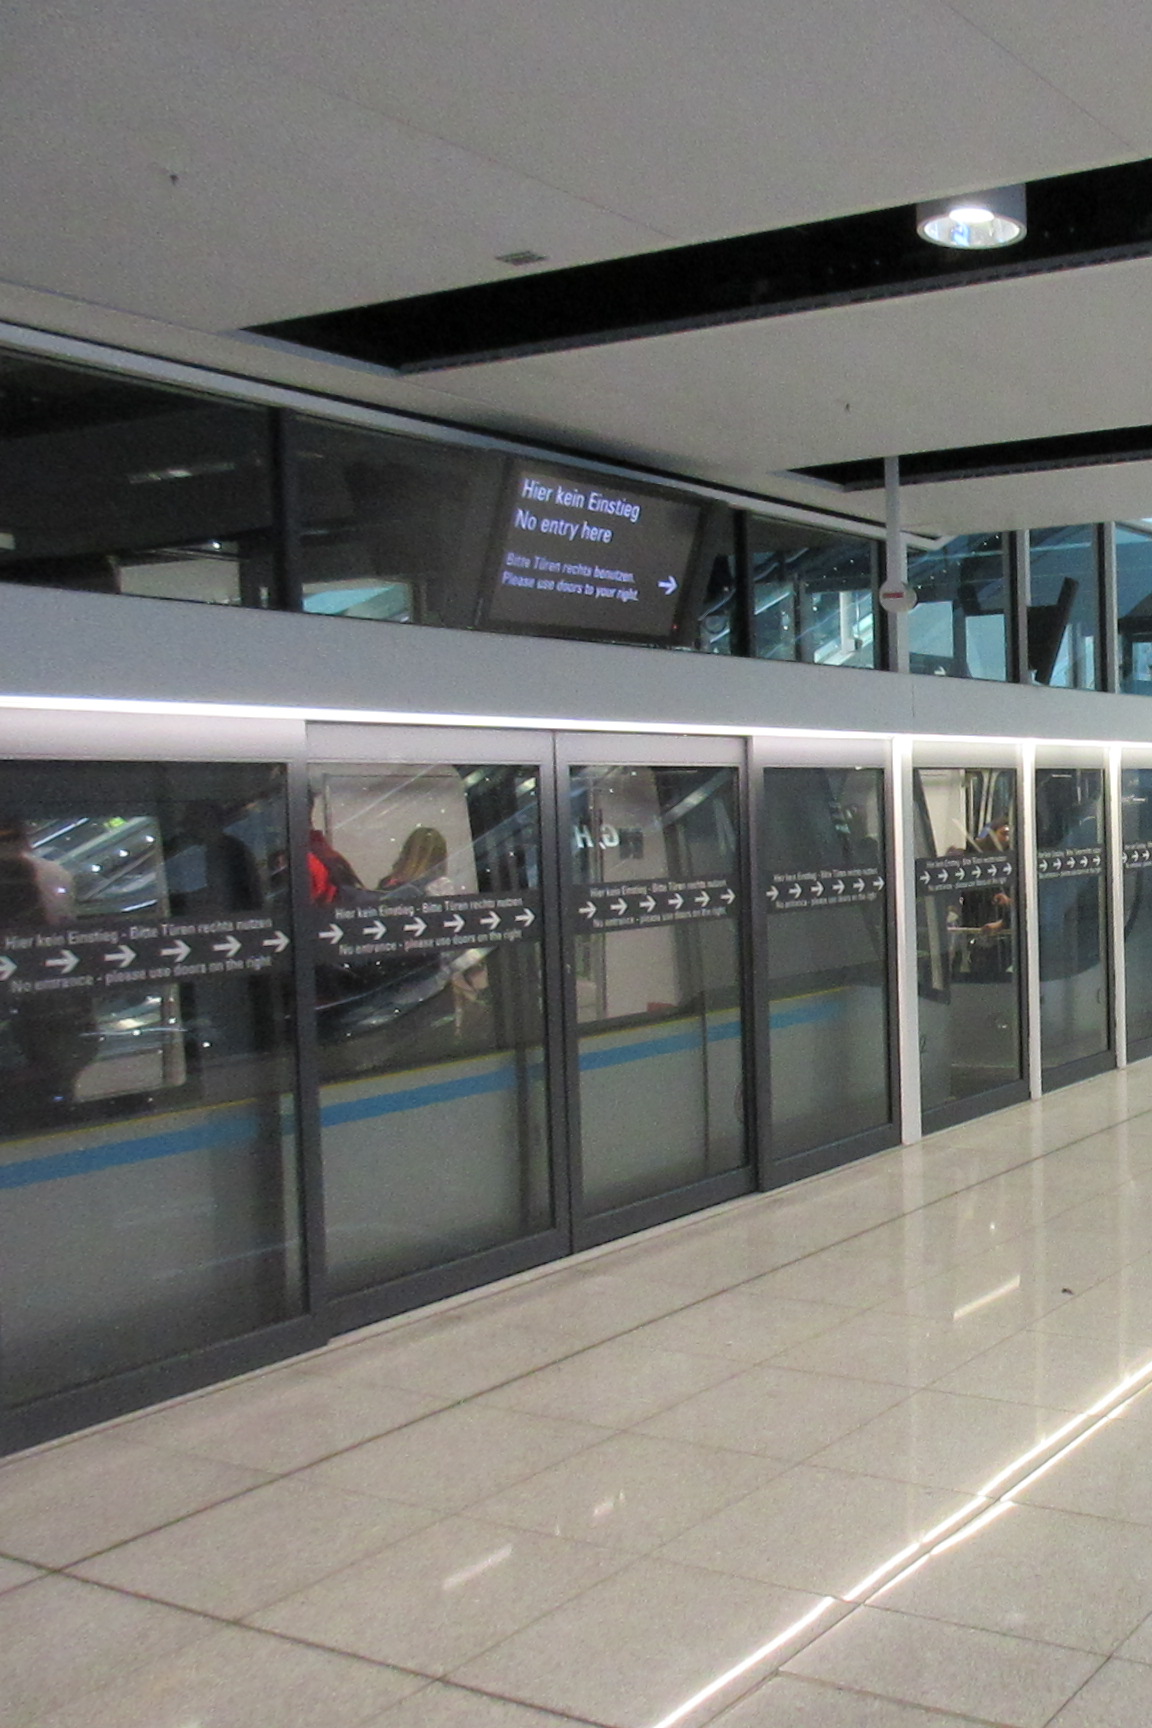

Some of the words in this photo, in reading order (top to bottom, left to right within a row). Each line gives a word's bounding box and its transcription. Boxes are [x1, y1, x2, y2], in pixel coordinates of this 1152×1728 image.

[521, 478, 553, 501] Hier
[555, 485, 584, 508] kein
[587, 491, 641, 522] Einstieg
[514, 508, 537, 531] No
[540, 517, 580, 541] entry
[581, 521, 613, 544] here
[506, 552, 531, 569] Bitte
[533, 555, 561, 573] Türen
[562, 561, 592, 577] rechts
[502, 571, 535, 588] Please
[537, 579, 555, 591] use
[556, 579, 583, 594] doors
[584, 583, 595, 596] to
[596, 586, 616, 599] your
[335, 908, 355, 919] Hier
[357, 906, 377, 918] kein
[5, 935, 33, 949] Hier
[37, 932, 65, 946] kein
[67, 930, 118, 945] Einstieg
[130, 925, 159, 940] Bitte
[162, 922, 195, 936] Türen
[12, 979, 31, 993] No
[105, 969, 147, 986] please
[150, 967, 171, 979] use
[174, 963, 206, 977] doors
[209, 961, 224, 972] on
[226, 958, 244, 971] the
[246, 956, 273, 971] right
